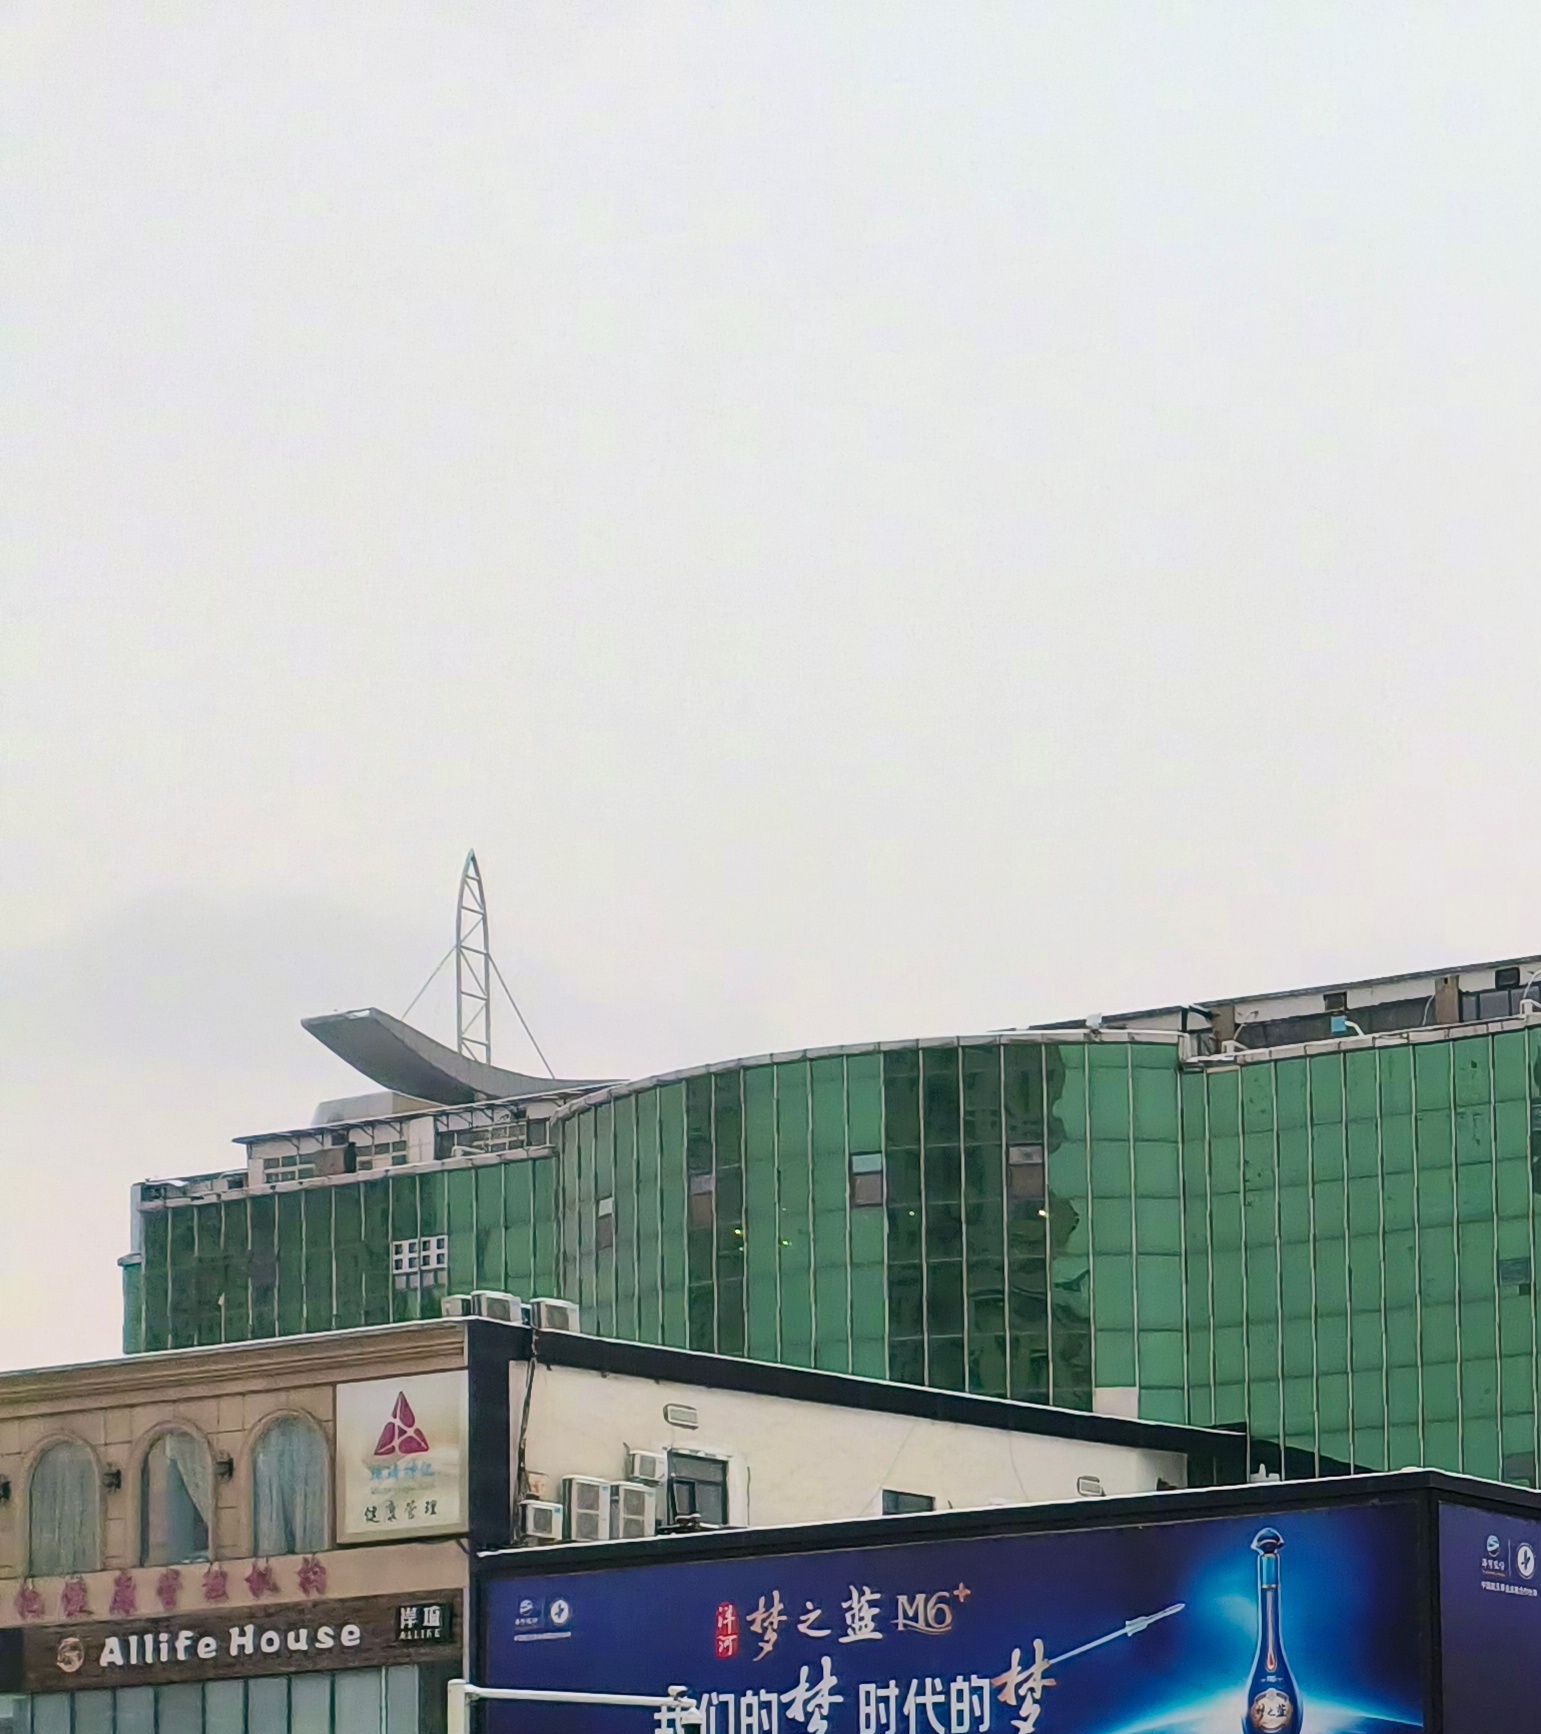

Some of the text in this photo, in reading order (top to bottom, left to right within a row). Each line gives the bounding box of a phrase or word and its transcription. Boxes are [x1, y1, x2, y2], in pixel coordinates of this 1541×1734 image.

[100, 1622, 361, 1667] Allife House
[746, 1585, 883, 1661] 梦之蓝
